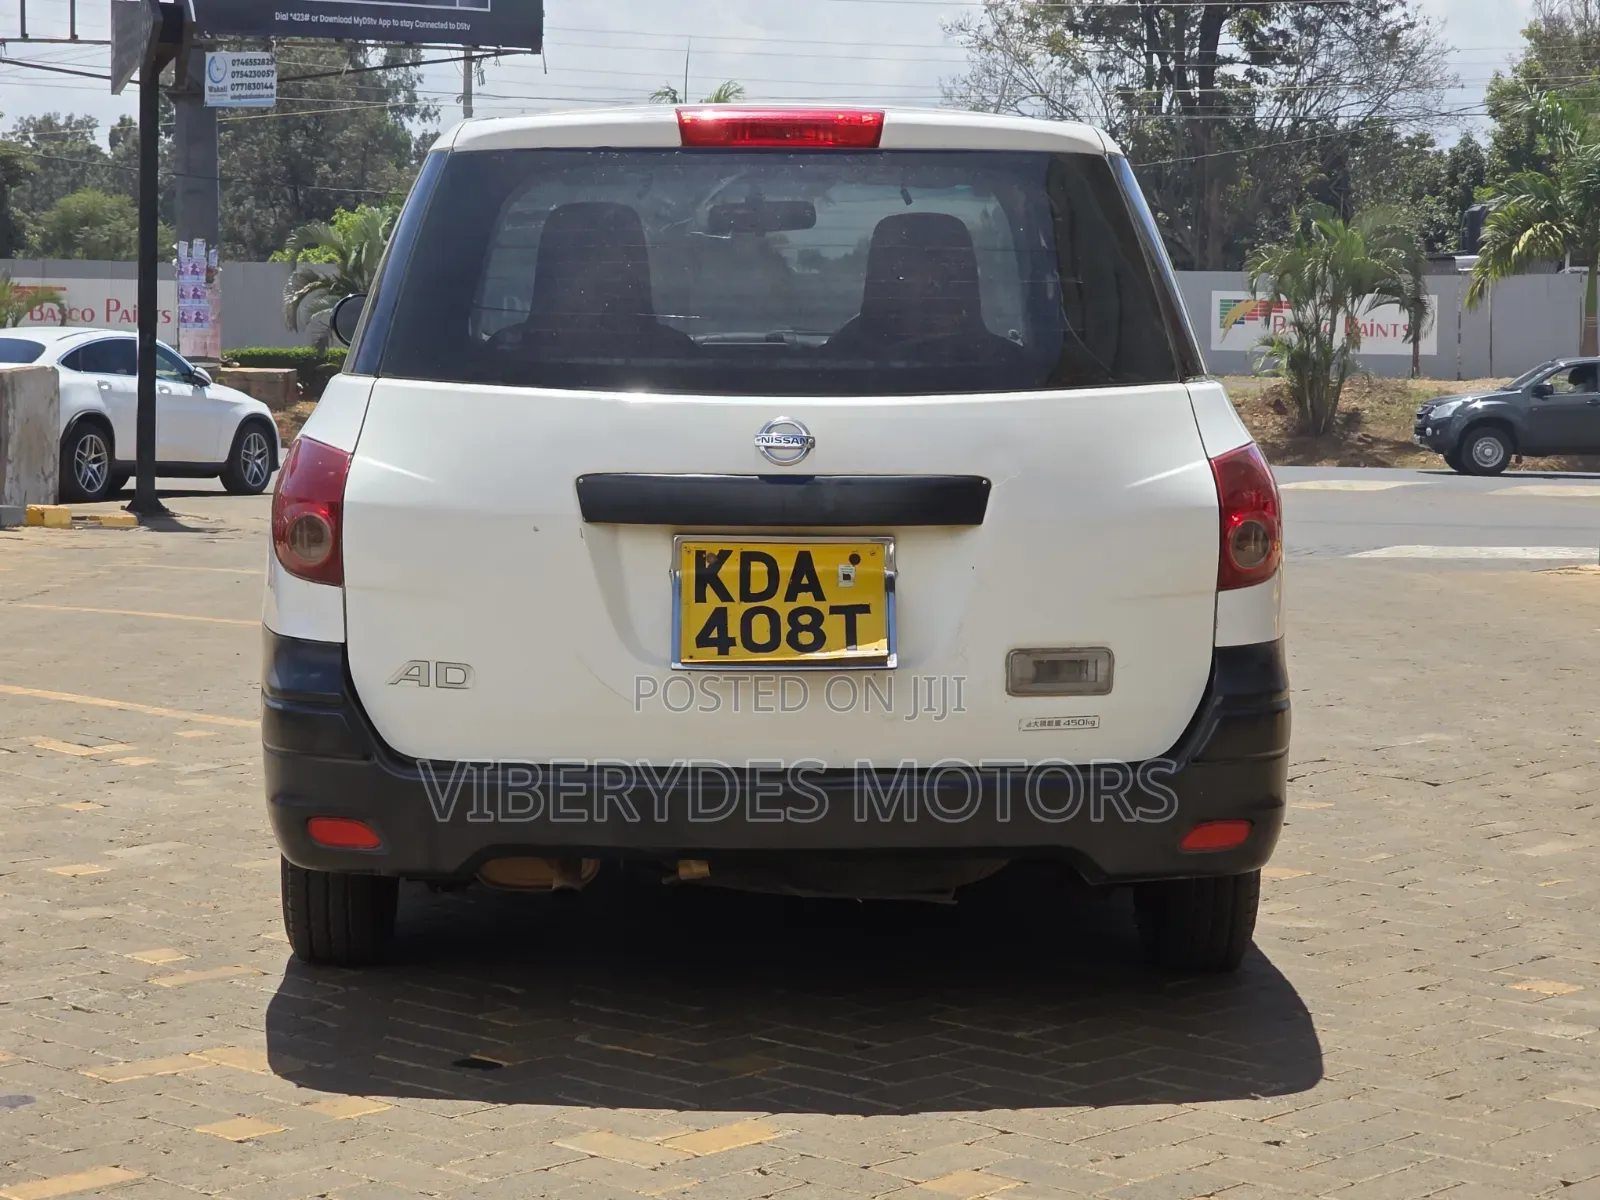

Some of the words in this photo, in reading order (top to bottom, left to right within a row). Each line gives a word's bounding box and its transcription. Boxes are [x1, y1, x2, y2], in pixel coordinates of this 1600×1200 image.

[274, 12, 289, 21] Dial
[319, 14, 352, 24] Download
[353, 16, 377, 27] MyDStv
[378, 18, 391, 28] App
[392, 19, 399, 27] to
[400, 19, 414, 29] stay
[414, 20, 448, 30] Connected
[449, 22, 456, 30] to
[456, 22, 471, 31] DStv
[230, 82, 274, 91] 0771830144
[761, 436, 809, 445] NISSAN
[694, 549, 827, 604] KDA
[694, 603, 872, 656] 408T
[386, 659, 475, 689] AD
[1062, 718, 1096, 727] 450kg
